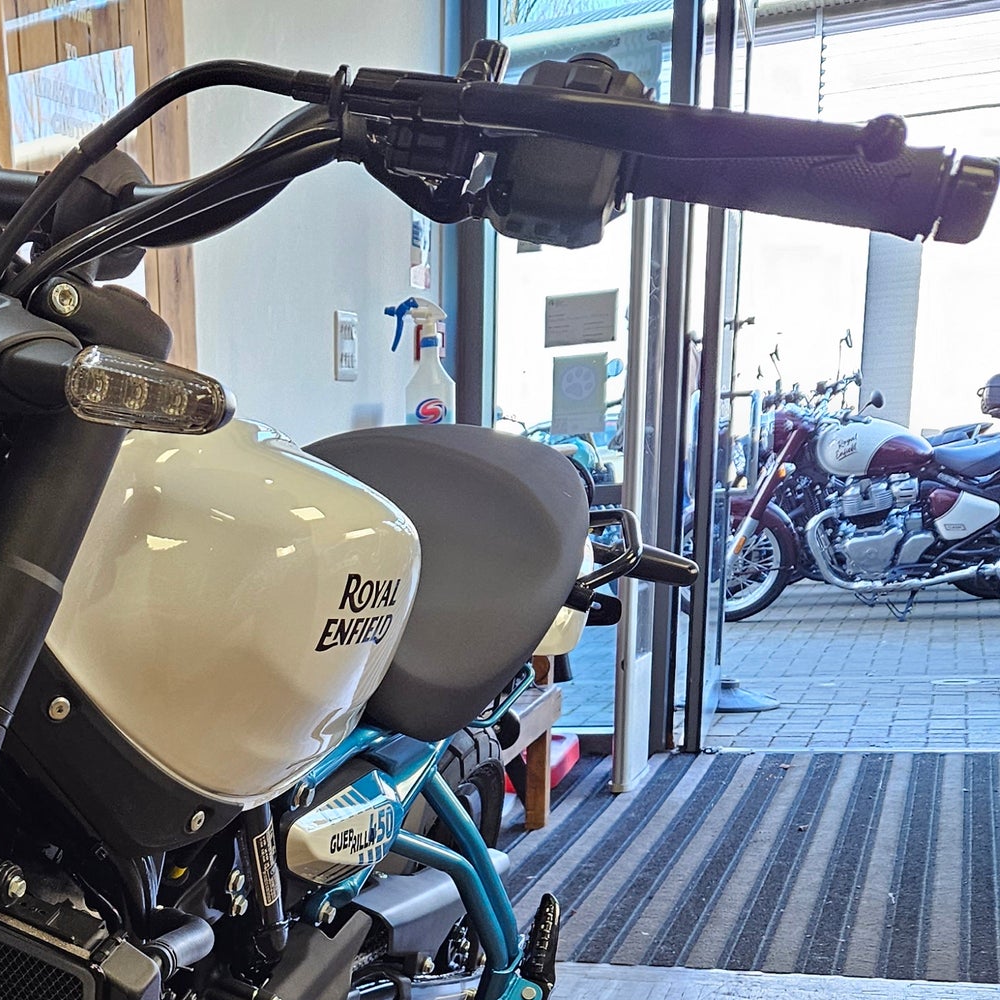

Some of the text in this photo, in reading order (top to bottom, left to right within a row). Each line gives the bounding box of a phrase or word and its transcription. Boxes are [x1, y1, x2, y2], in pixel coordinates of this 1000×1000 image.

[314, 614, 393, 652] ENFIELD
[330, 805, 394, 855] GUERRILLA 450
